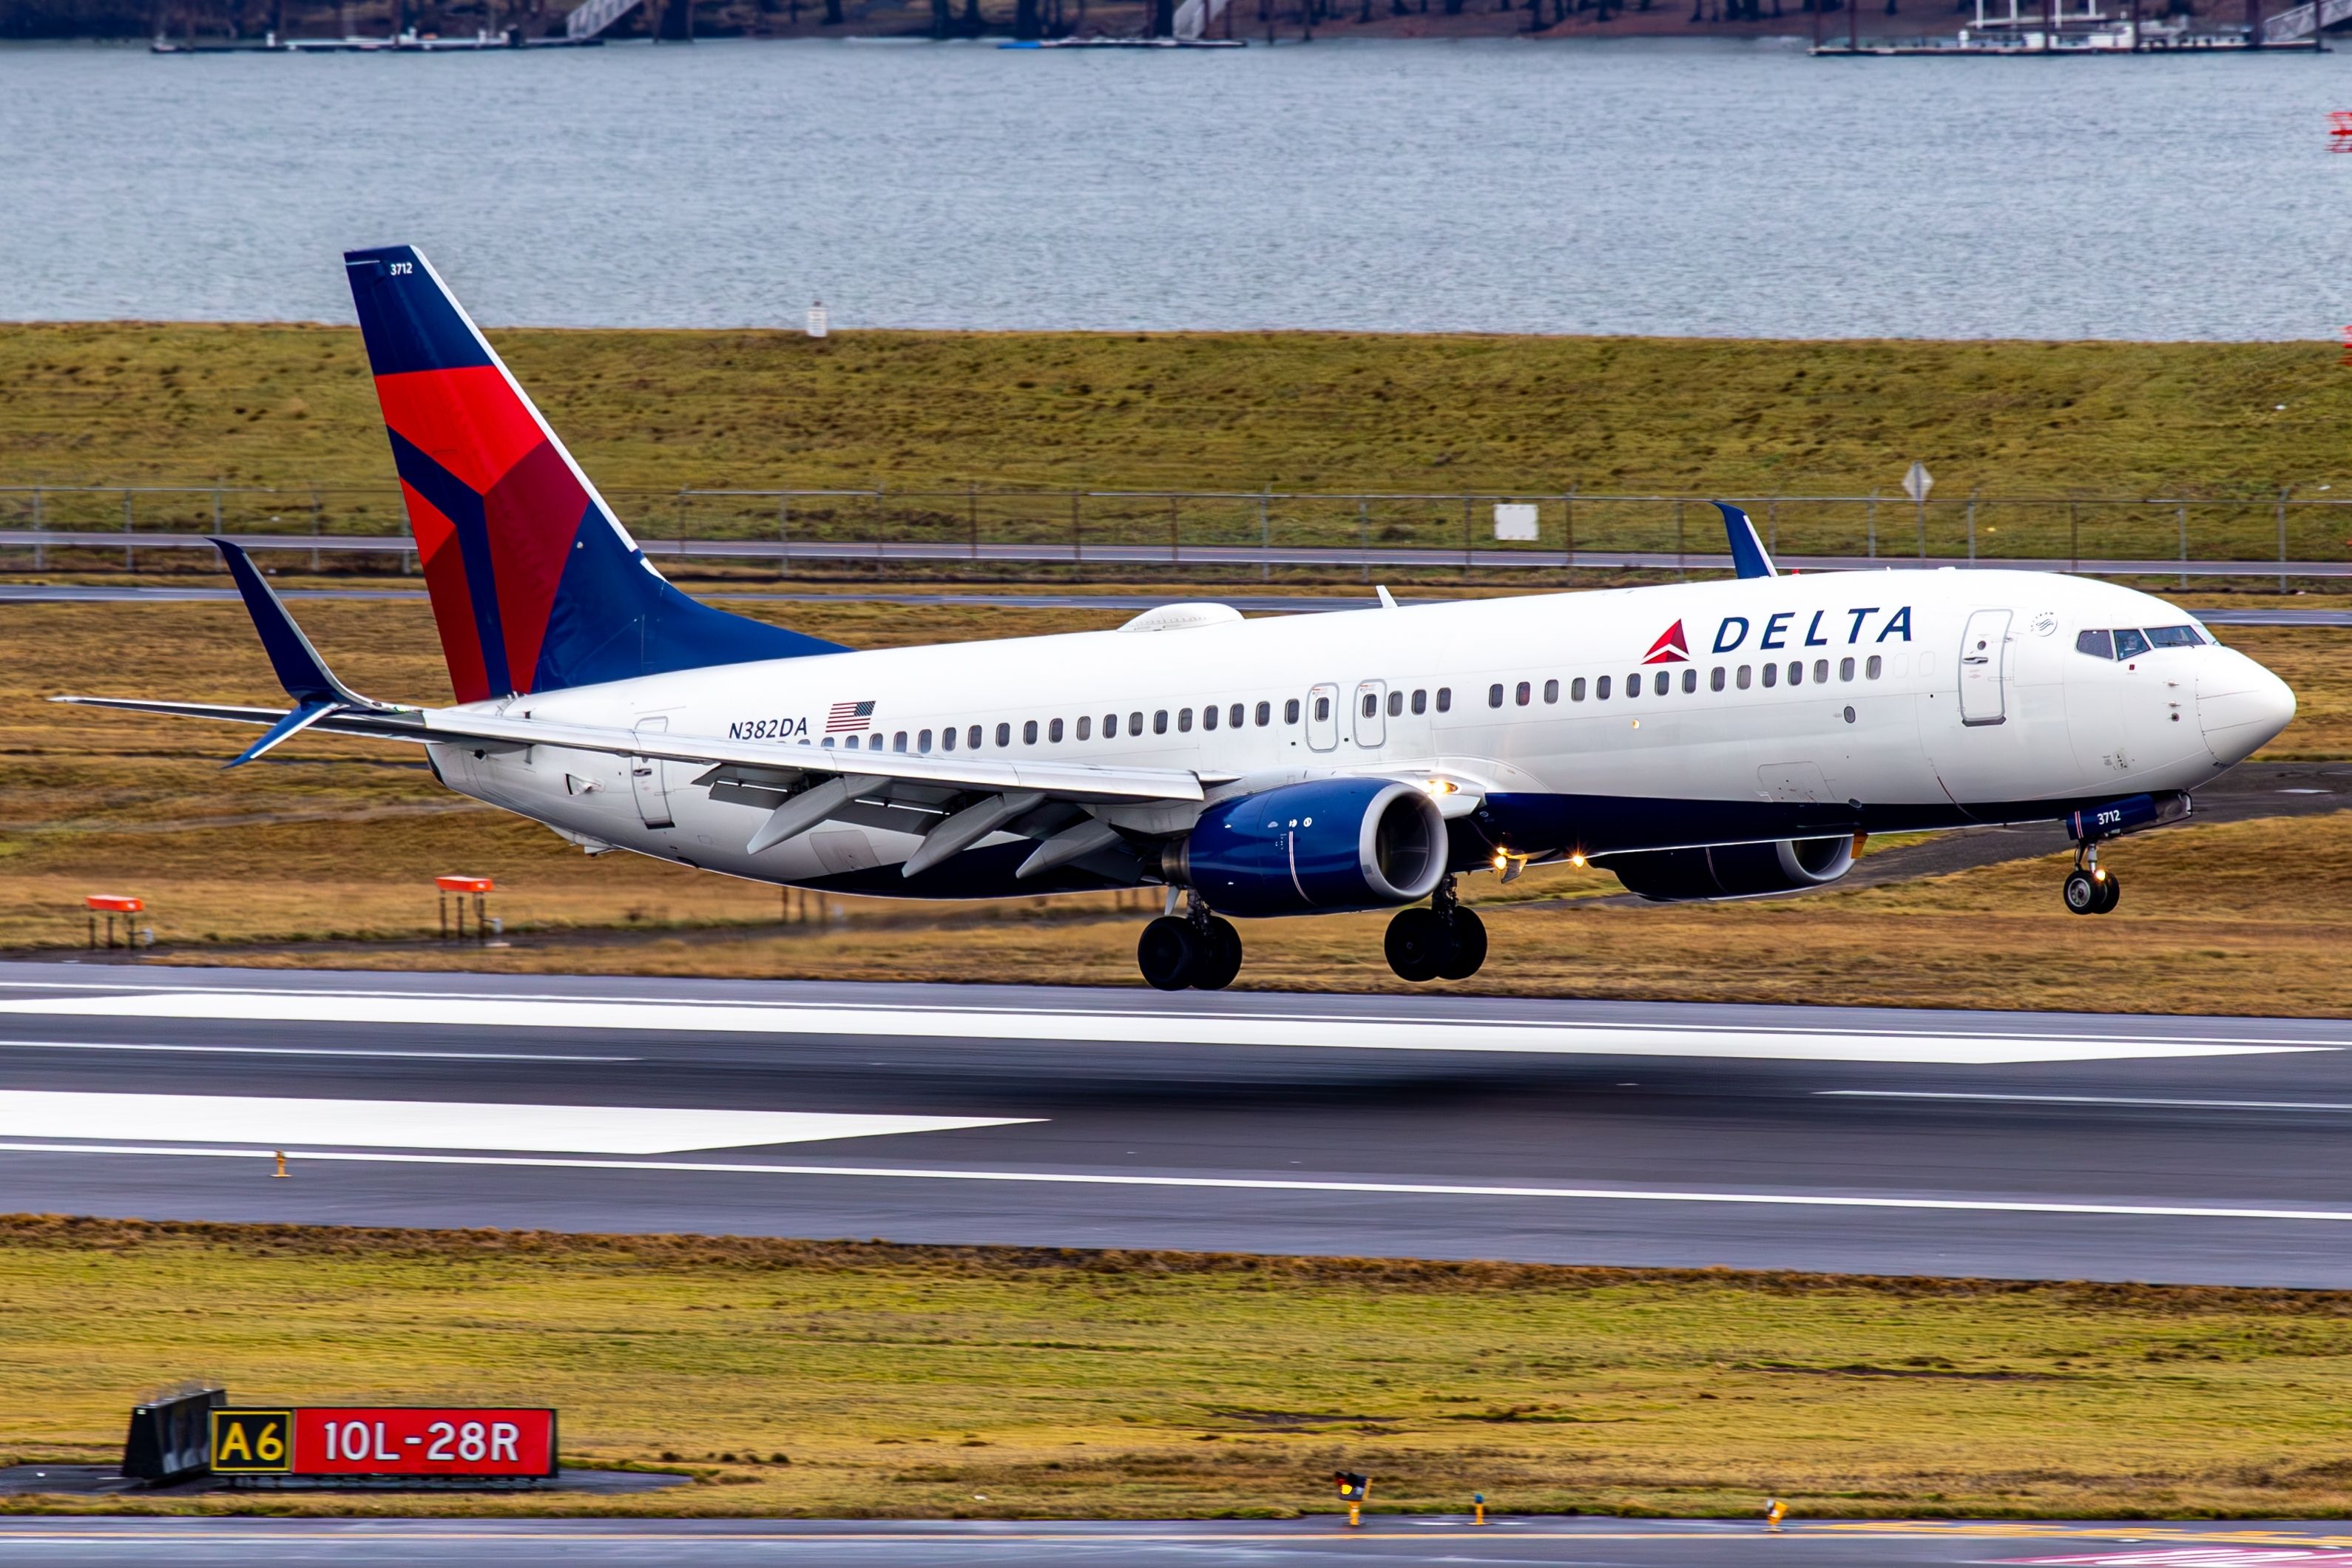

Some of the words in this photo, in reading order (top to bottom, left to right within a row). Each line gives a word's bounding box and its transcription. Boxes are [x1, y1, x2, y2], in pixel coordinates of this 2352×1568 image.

[390, 262, 413, 276] 3712
[1711, 606, 1912, 654] DELTA
[729, 717, 808, 740] N382DA
[2097, 809, 2121, 825] 3712
[218, 1422, 284, 1461] A6
[323, 1421, 520, 1461] 10L-28R
